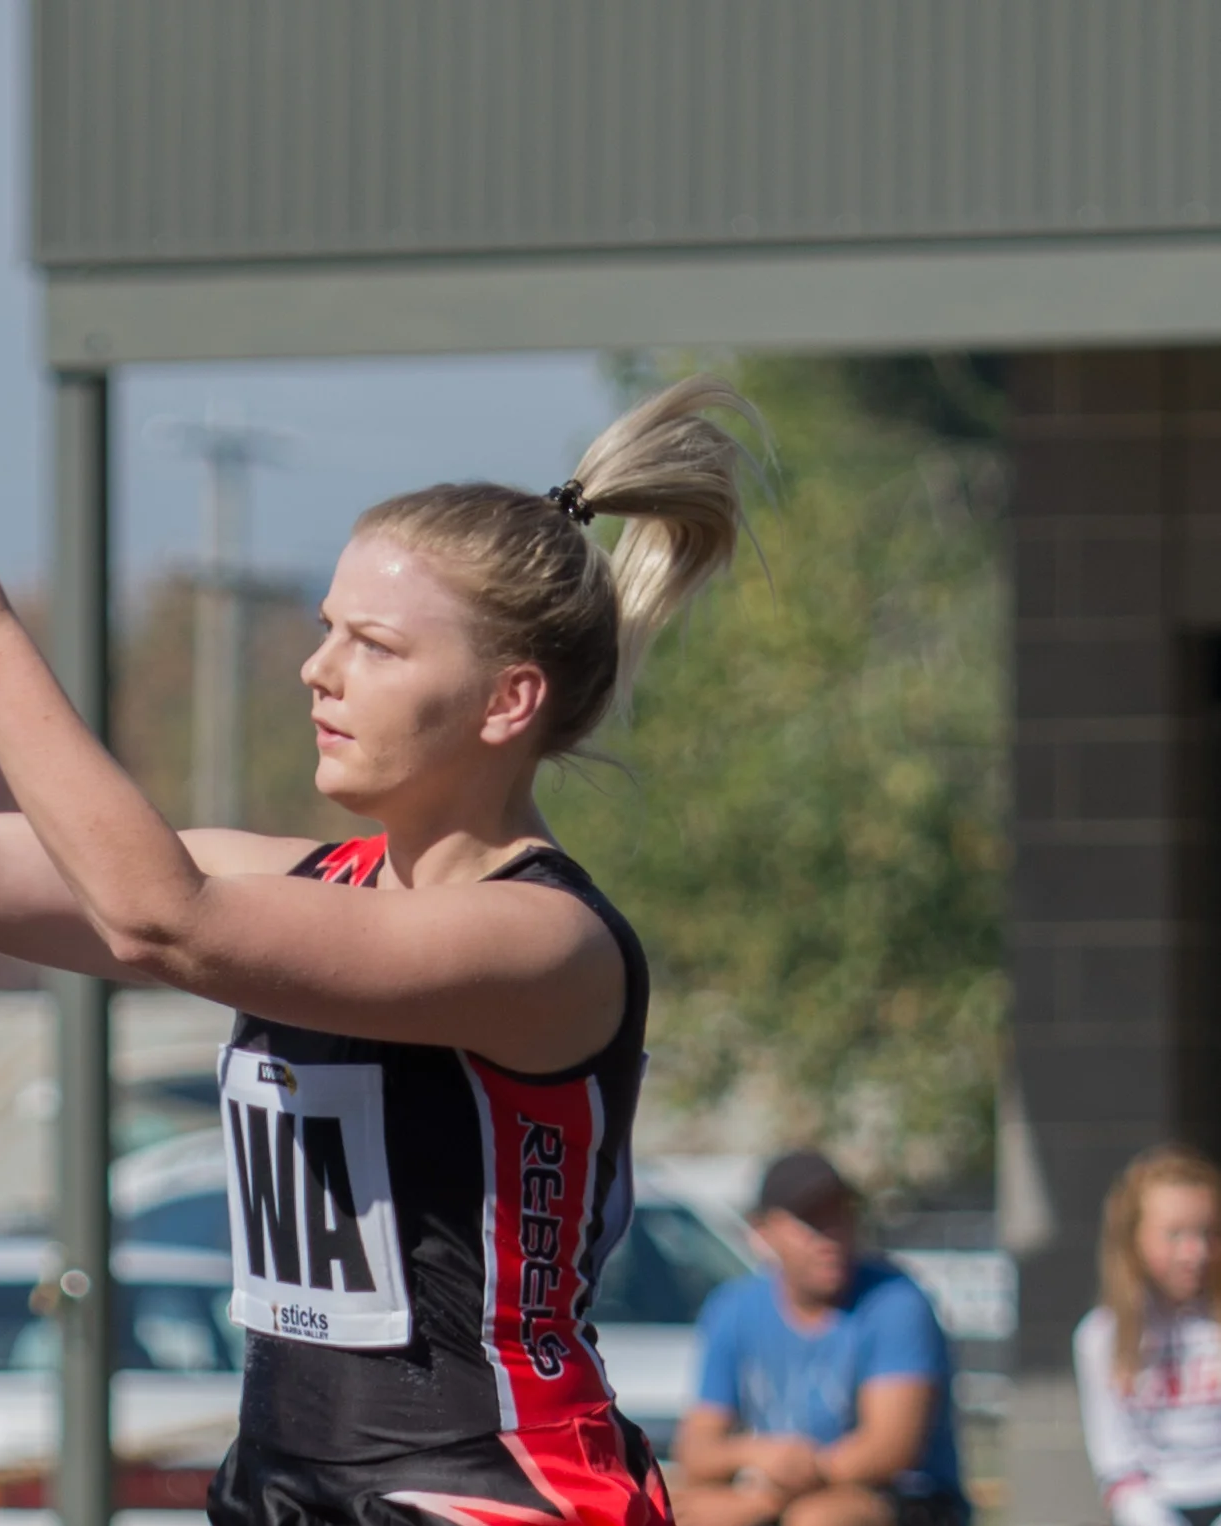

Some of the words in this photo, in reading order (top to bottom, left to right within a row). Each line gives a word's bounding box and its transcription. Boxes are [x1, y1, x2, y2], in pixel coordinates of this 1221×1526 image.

[228, 1098, 378, 1293] WA
[517, 1111, 571, 1381] REBELS
[281, 1303, 329, 1331] sticks
[281, 1326, 303, 1336] YARRA
[304, 1330, 329, 1340] VALLEY
